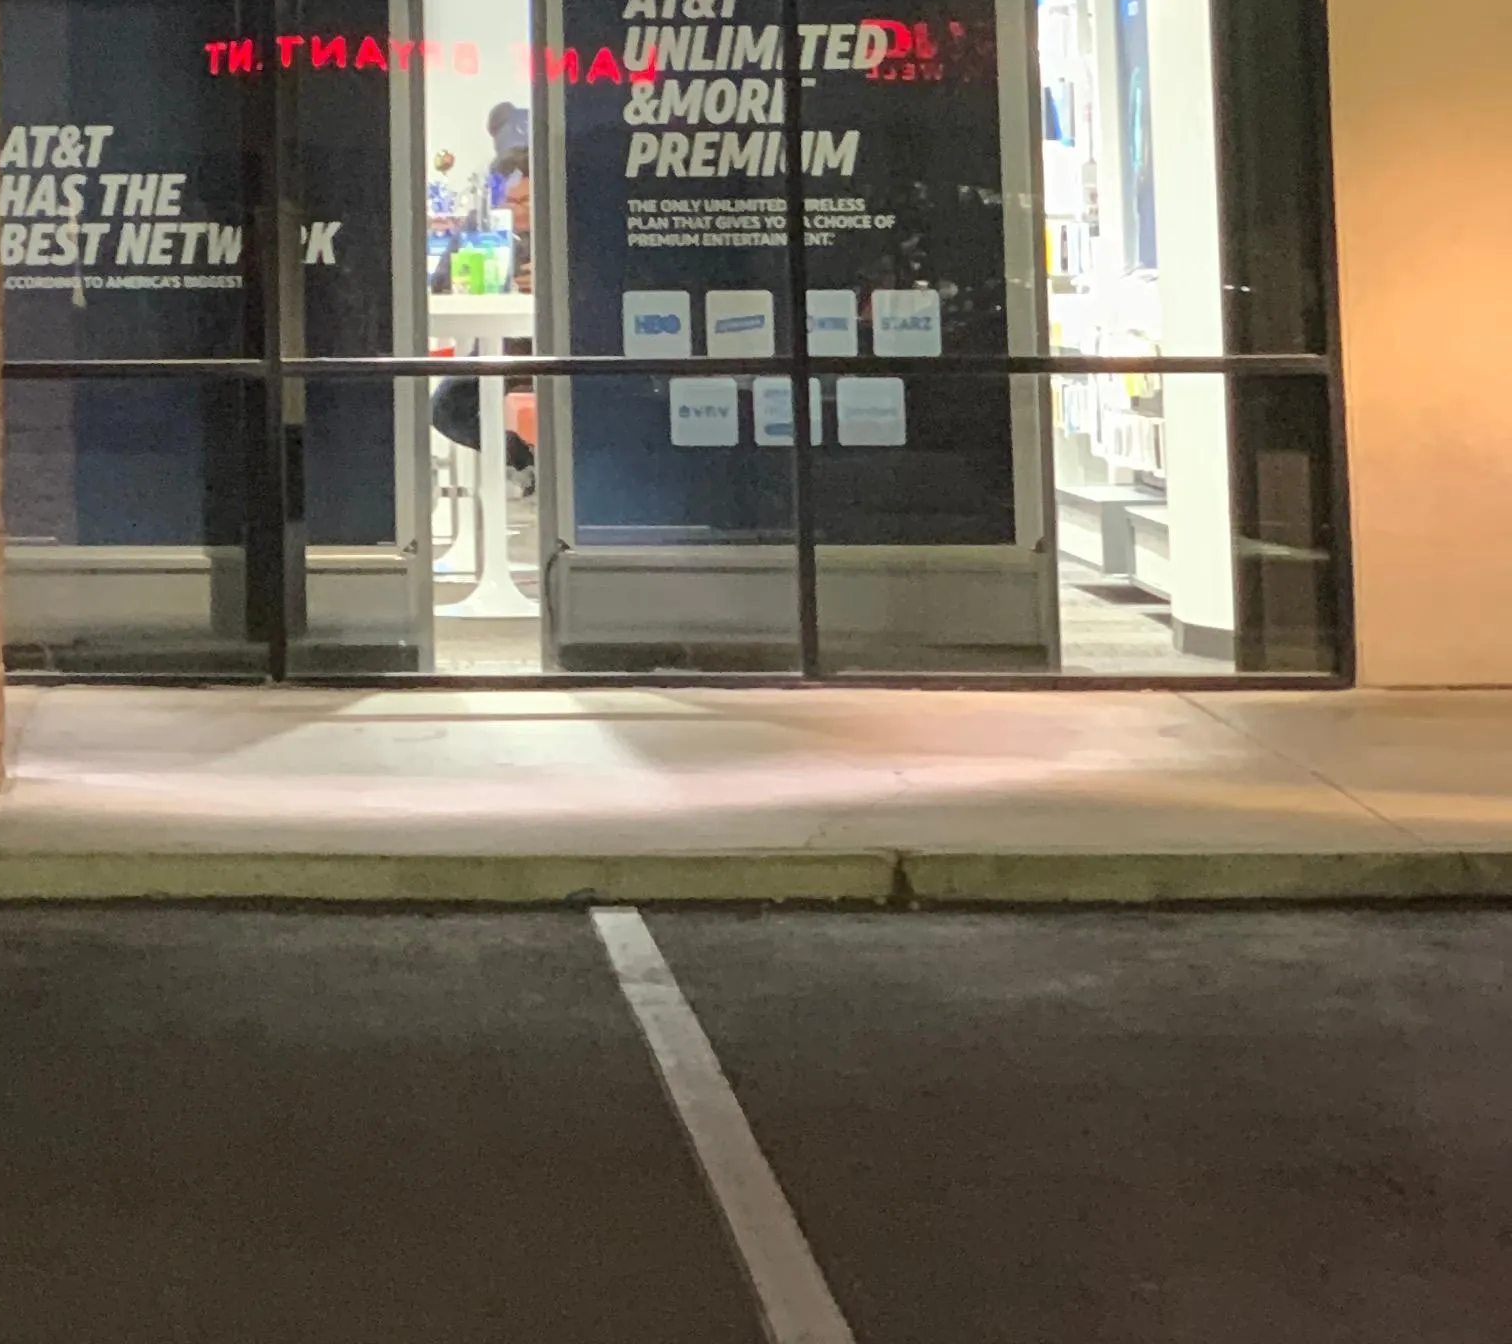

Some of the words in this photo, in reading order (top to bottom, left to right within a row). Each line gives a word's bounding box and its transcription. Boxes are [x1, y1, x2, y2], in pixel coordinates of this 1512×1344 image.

[0, 124, 114, 169] AT&T
[99, 173, 187, 217] THE
[628, 199, 657, 213] THE
[660, 199, 702, 213] ONLY
[628, 216, 669, 230] PLAN
[673, 216, 713, 230] THAT
[715, 215, 761, 229] GIVES
[813, 215, 872, 228] CHOICE
[874, 215, 896, 229] OF
[0, 222, 111, 266] BEST
[114, 221, 343, 266] NETWK
[5, 275, 83, 289] CCORDING
[85, 275, 104, 289] TO
